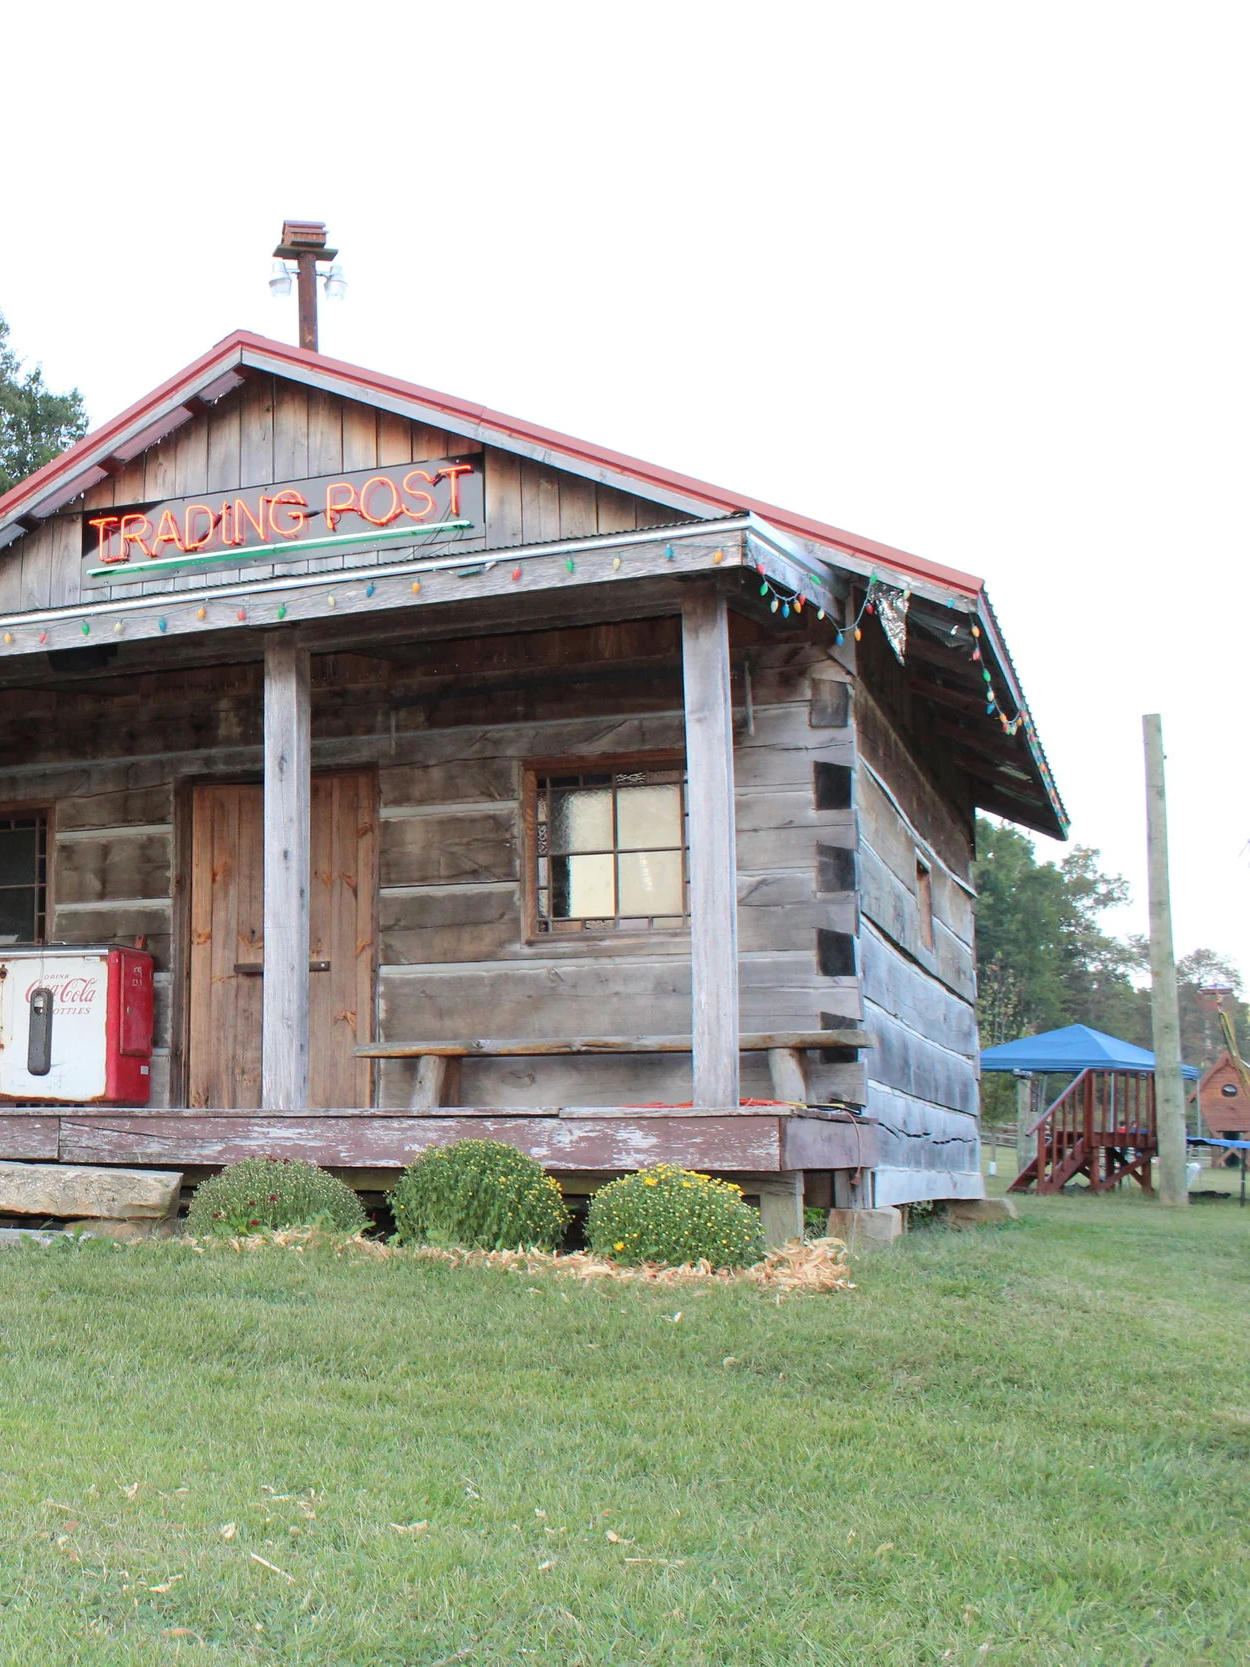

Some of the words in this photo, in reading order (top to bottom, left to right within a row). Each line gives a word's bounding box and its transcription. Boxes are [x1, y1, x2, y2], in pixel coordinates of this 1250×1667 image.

[88, 488, 308, 564] TRADING
[325, 463, 473, 530] POST
[24, 977, 98, 1004] Ca-Cola
[52, 1007, 91, 1015] OTTLES
